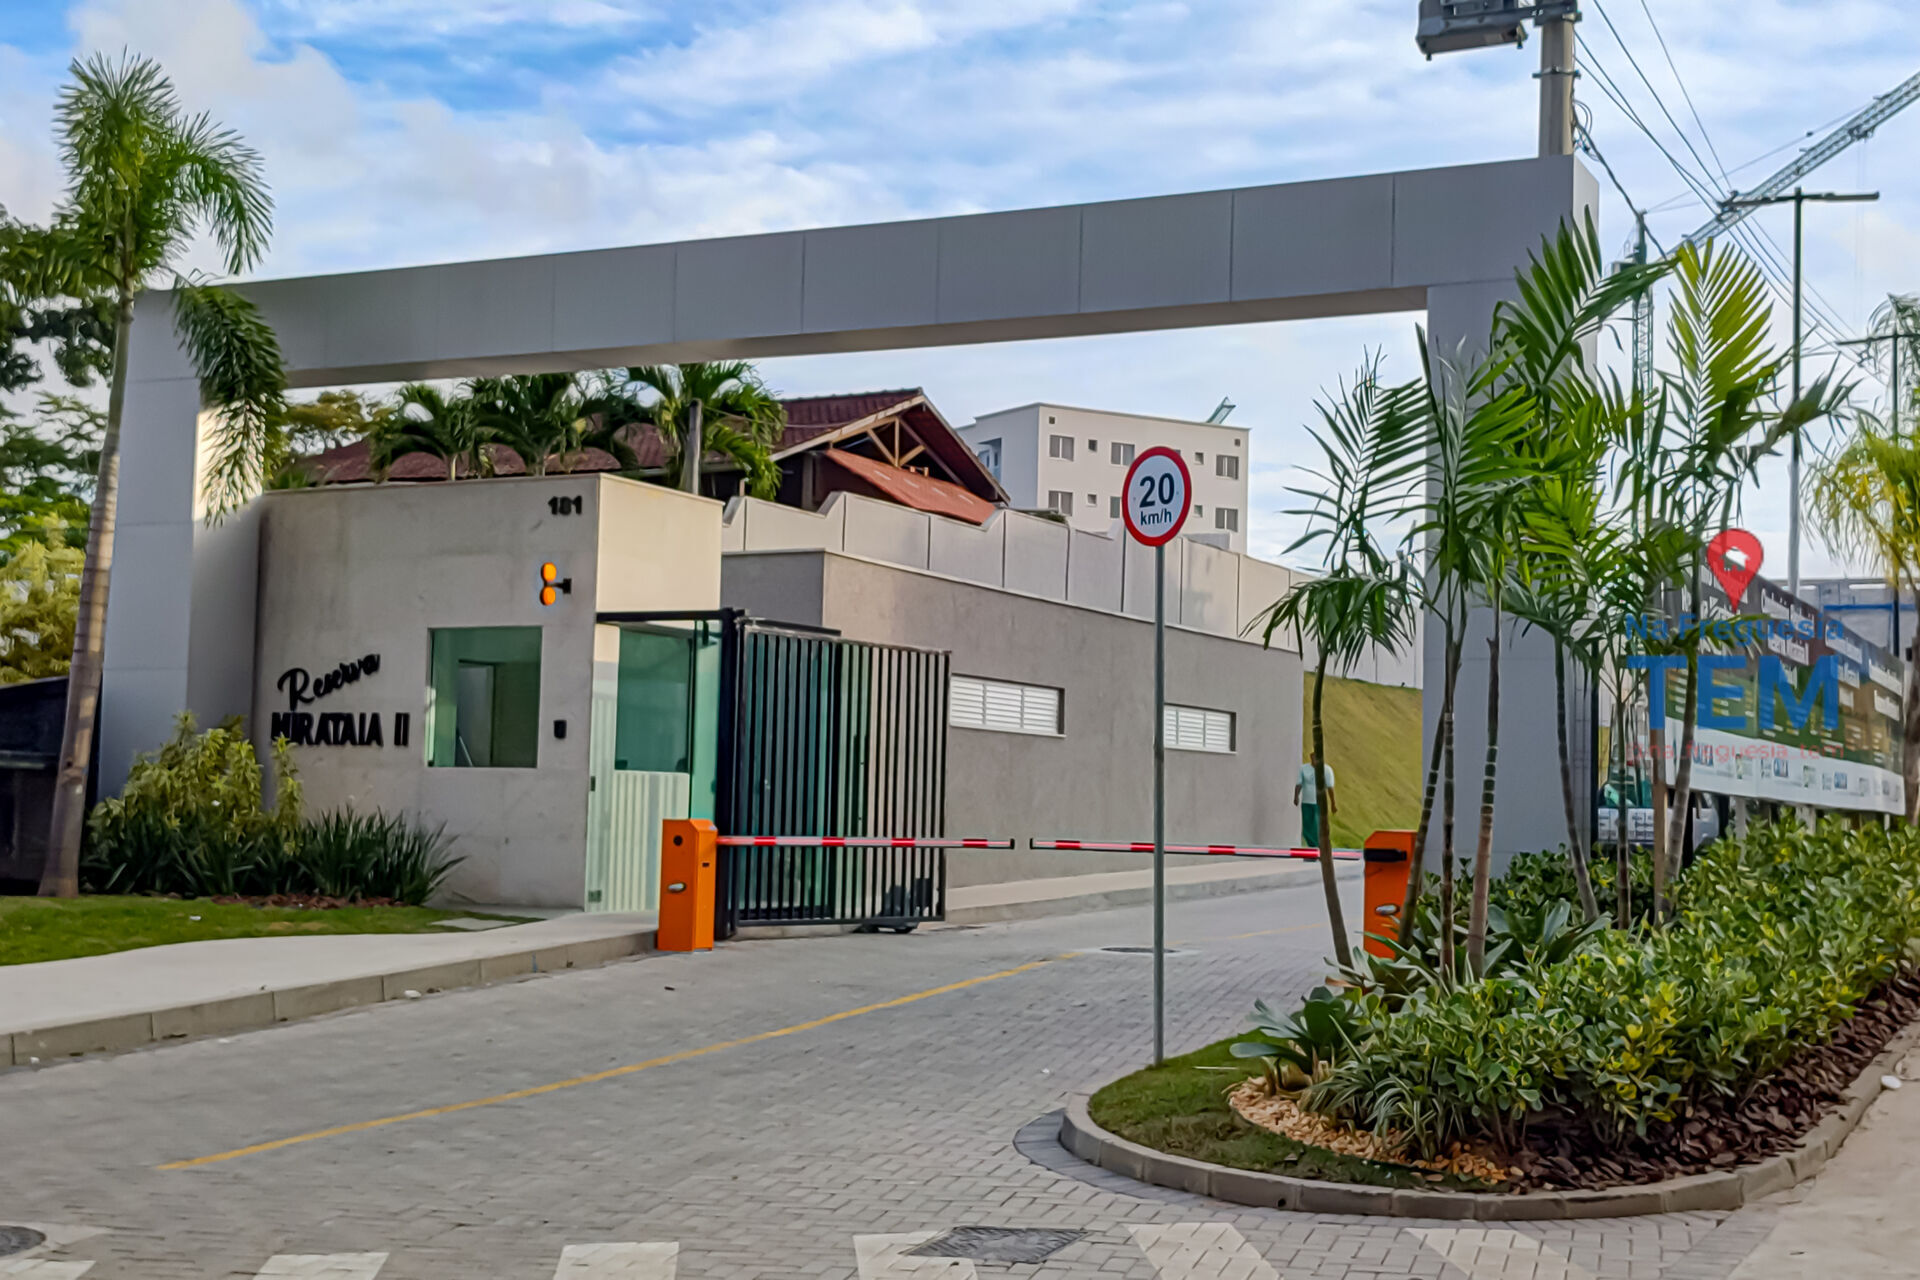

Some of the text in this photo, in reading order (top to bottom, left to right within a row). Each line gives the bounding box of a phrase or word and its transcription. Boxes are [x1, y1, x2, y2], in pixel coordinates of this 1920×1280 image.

[1139, 472, 1175, 508] 20
[1140, 507, 1172, 525] km/h
[277, 653, 381, 712] Reserva
[271, 712, 410, 747] MIRATAIA II
